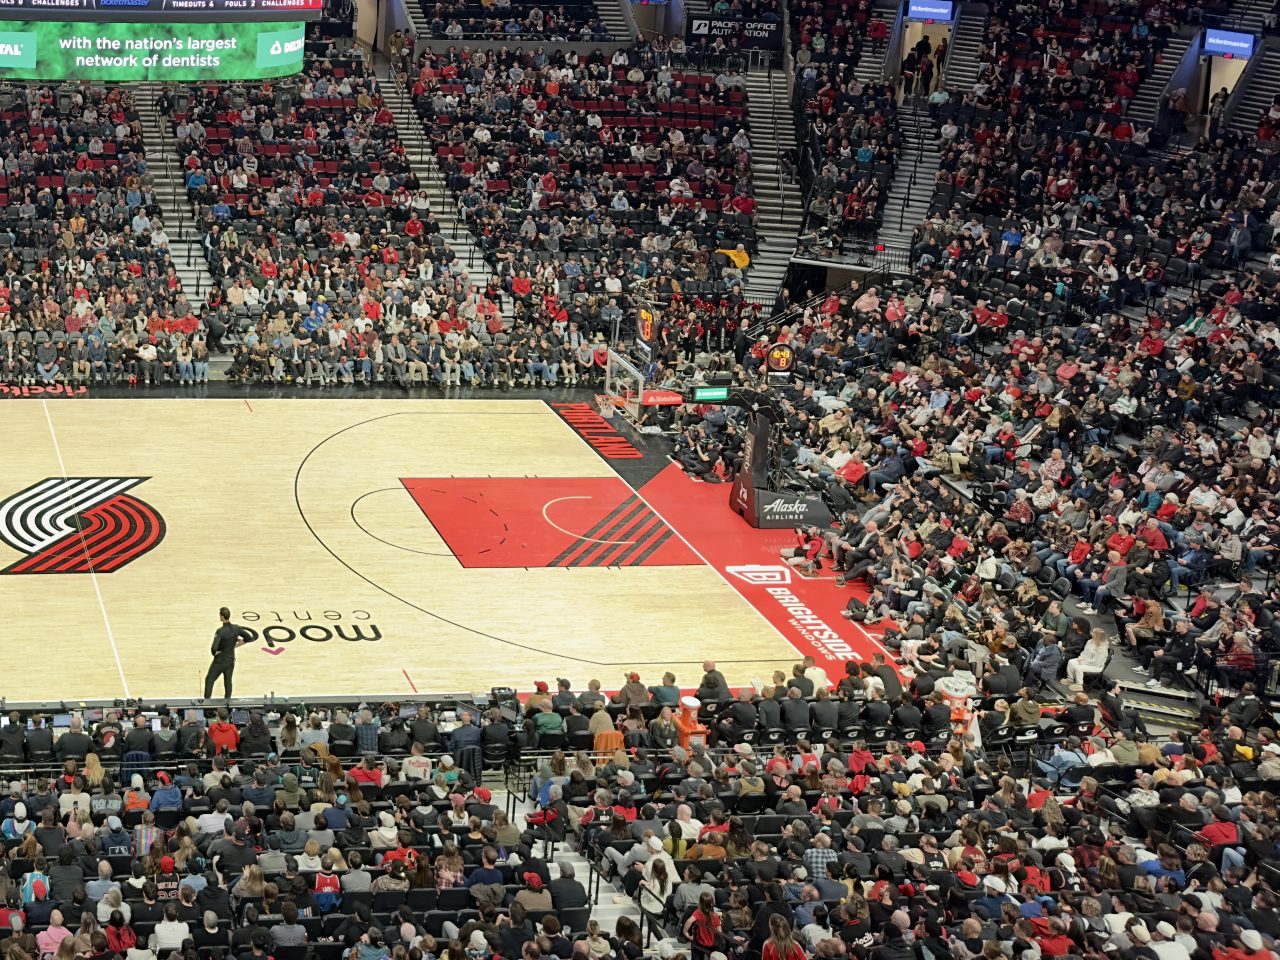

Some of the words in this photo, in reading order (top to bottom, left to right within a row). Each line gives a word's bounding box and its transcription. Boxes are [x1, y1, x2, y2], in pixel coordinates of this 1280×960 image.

[172, 0, 206, 8] TIMEOUTS
[910, 5, 950, 13] ticketmaster
[745, 22, 777, 30] OFFICE
[59, 37, 92, 50] with
[96, 37, 120, 50] the
[125, 37, 183, 50] nation's
[187, 37, 237, 53] largest
[1208, 37, 1250, 49] ticketmaster
[76, 54, 138, 67] network
[141, 53, 158, 67] of
[162, 53, 220, 67] dentists
[779, 358, 786, 367] 8
[551, 401, 644, 459] PORTLAND
[763, 498, 808, 512] Alaska.
[241, 610, 371, 623] cente
[766, 587, 864, 661] BRIGHTSIDE
[238, 624, 383, 647] moda
[788, 618, 836, 661] WINDOWS
